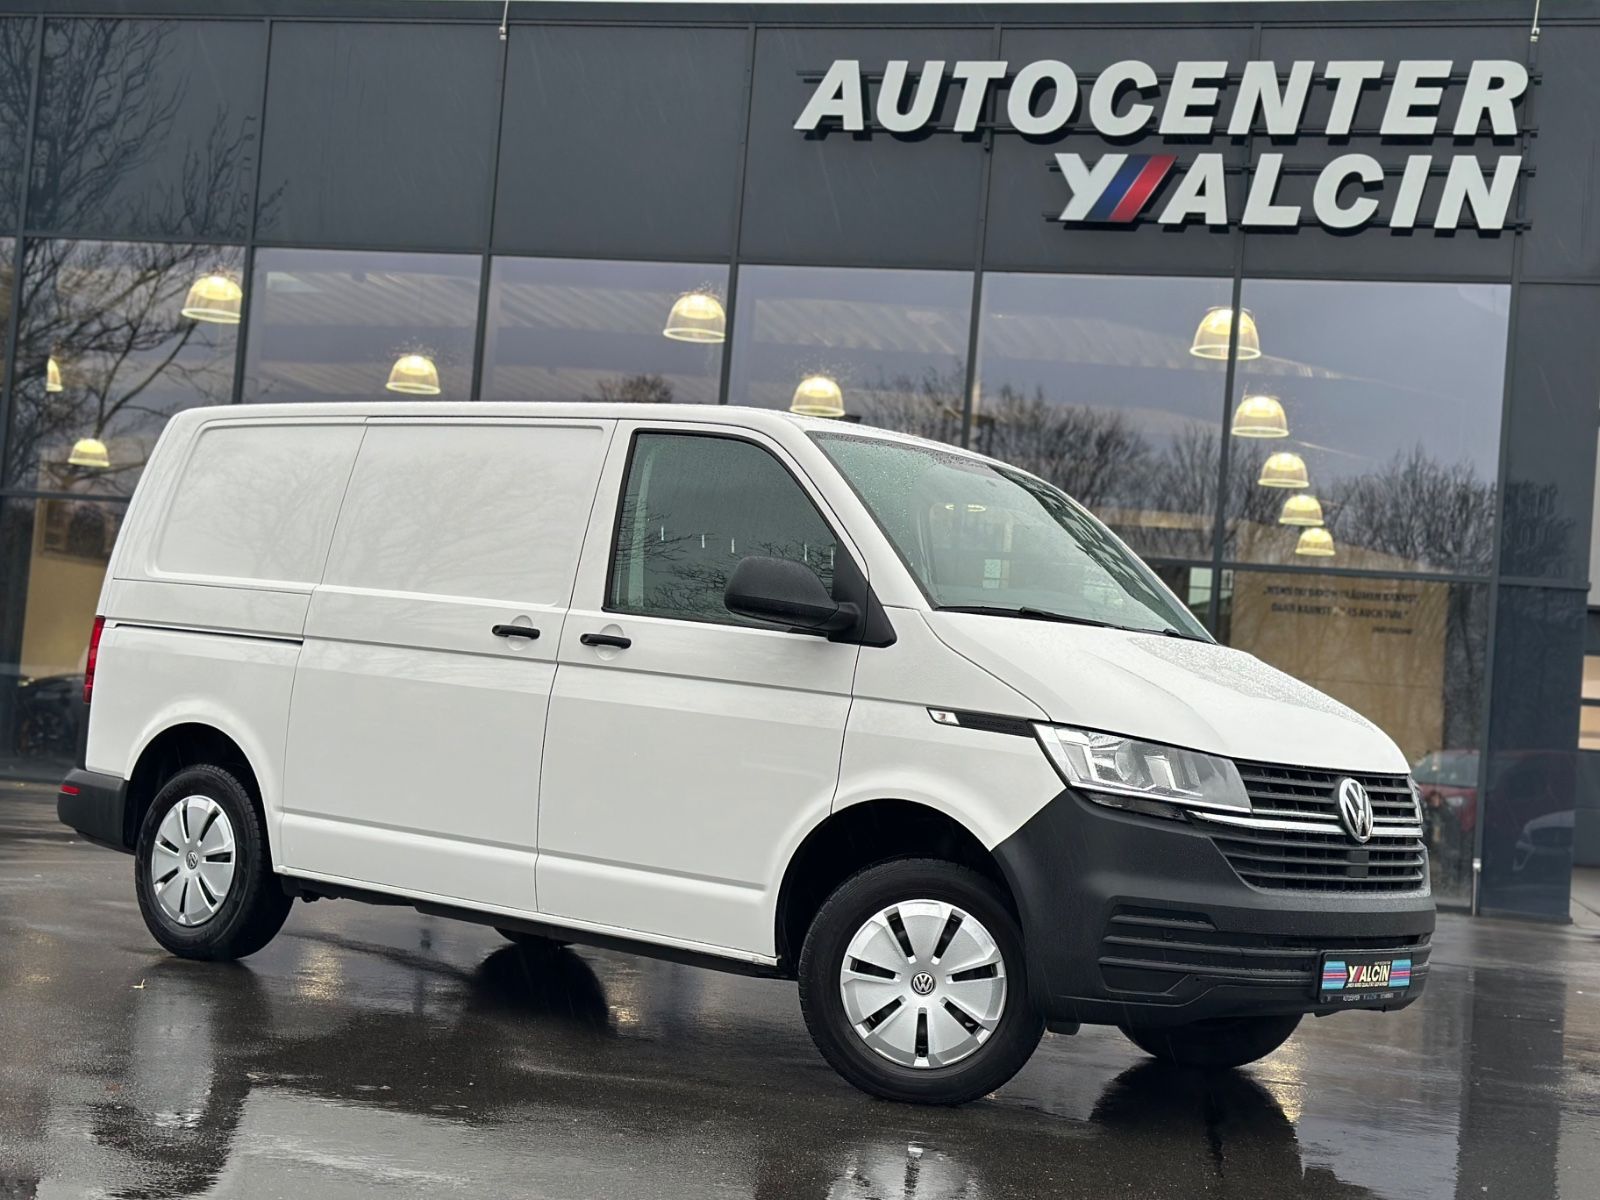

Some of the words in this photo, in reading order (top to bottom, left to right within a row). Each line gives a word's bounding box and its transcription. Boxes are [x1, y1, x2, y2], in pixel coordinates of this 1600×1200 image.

[793, 60, 1529, 137] AUTOCENTER
[1055, 153, 1522, 229] YALCIN
[1348, 965, 1390, 982] YALCIN
